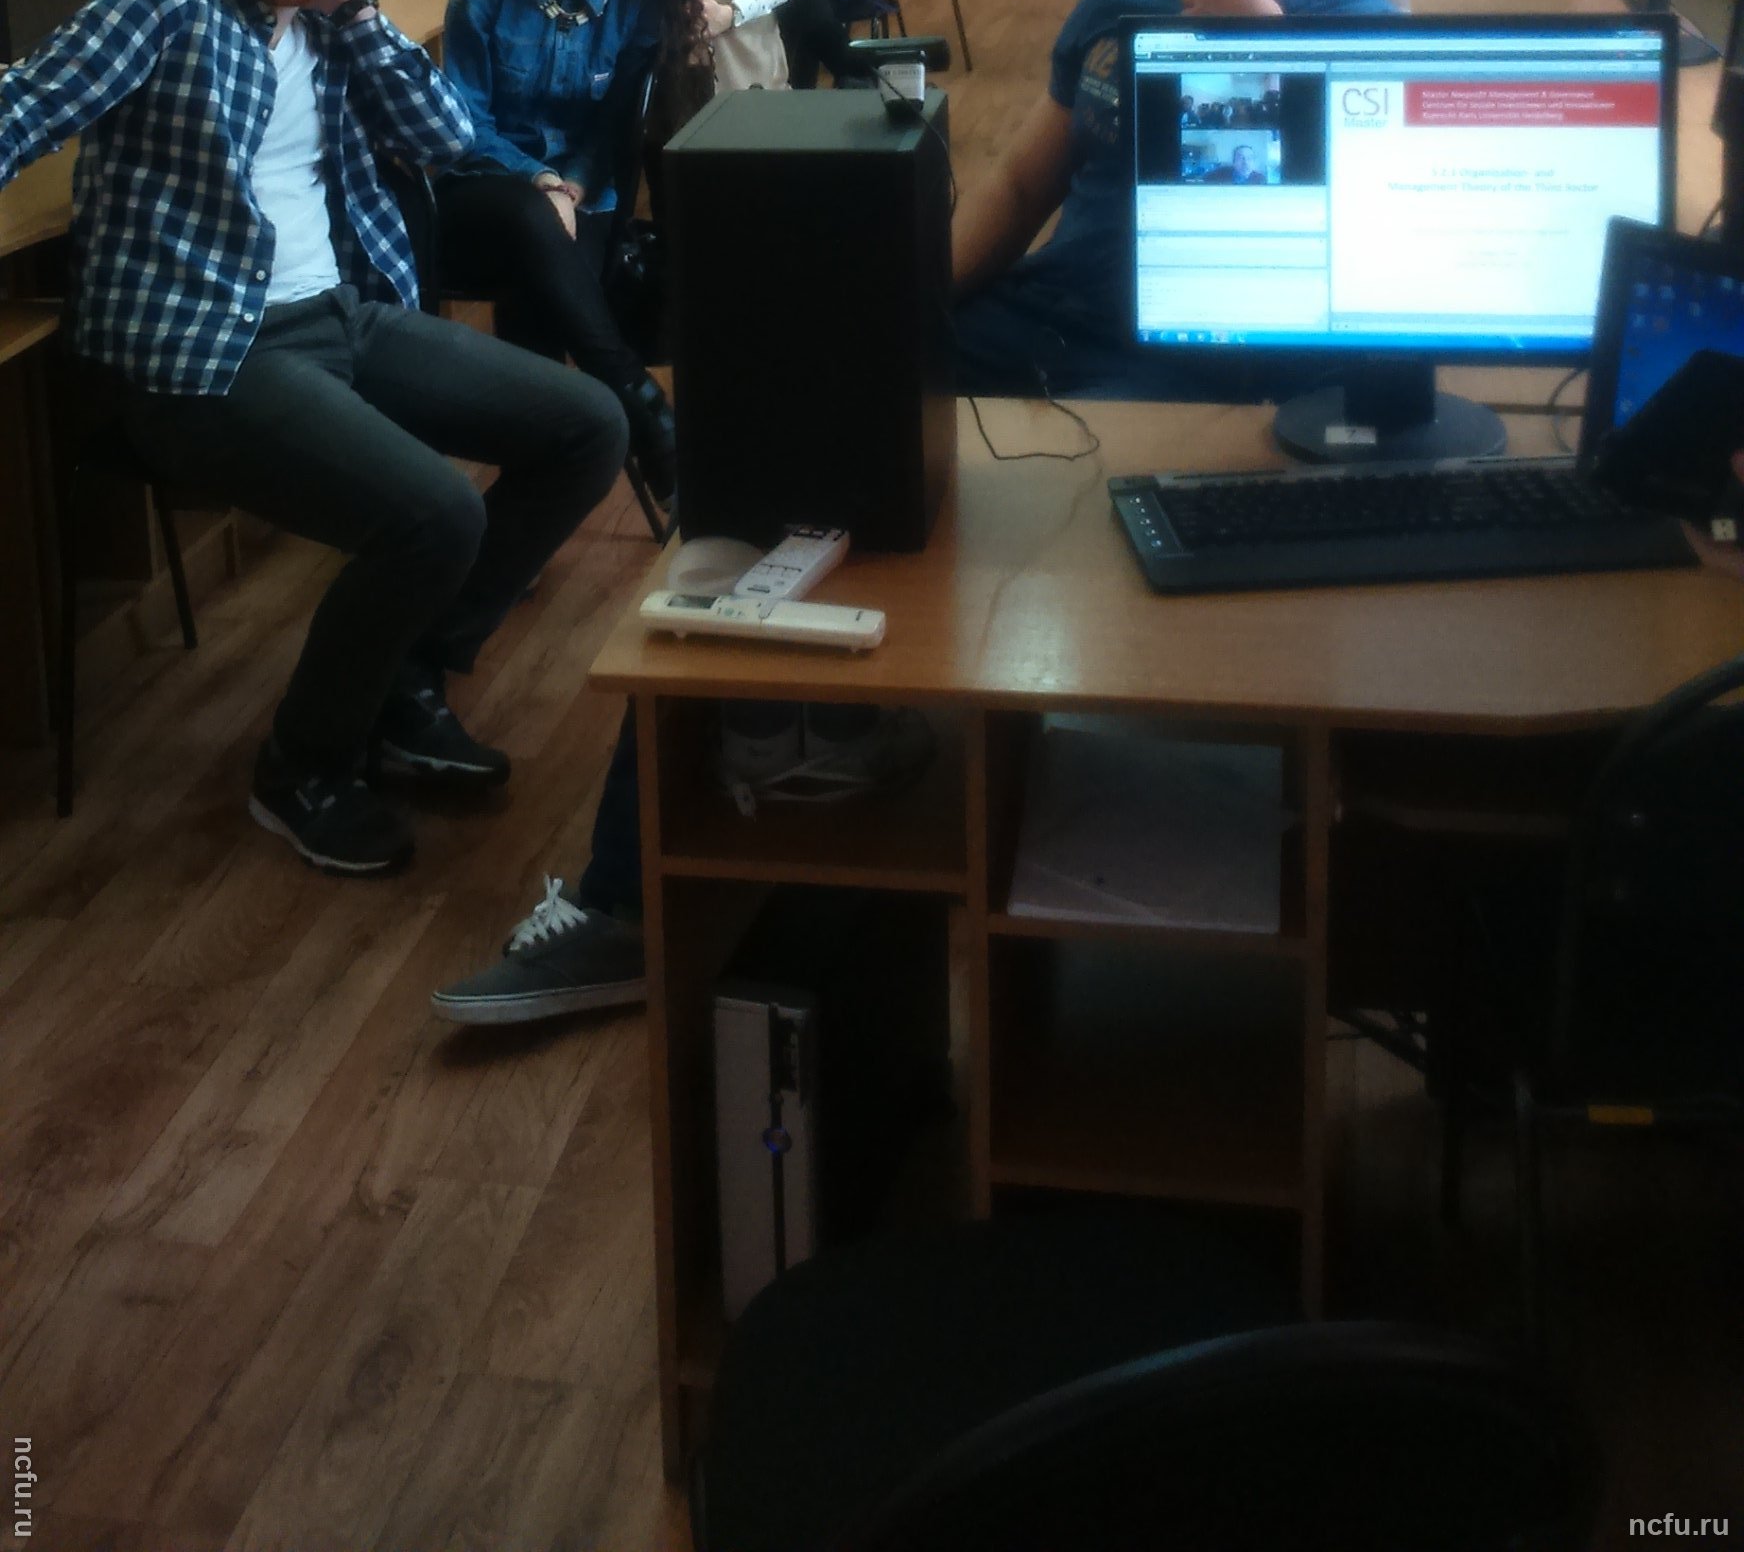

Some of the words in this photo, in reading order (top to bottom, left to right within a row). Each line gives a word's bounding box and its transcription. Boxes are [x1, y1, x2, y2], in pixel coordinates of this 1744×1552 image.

[1342, 88, 1388, 115] CSI
[1344, 118, 1387, 128] Master
[1388, 182, 1457, 194] Management
[1461, 181, 1497, 194] Theory
[1514, 181, 1531, 192] the
